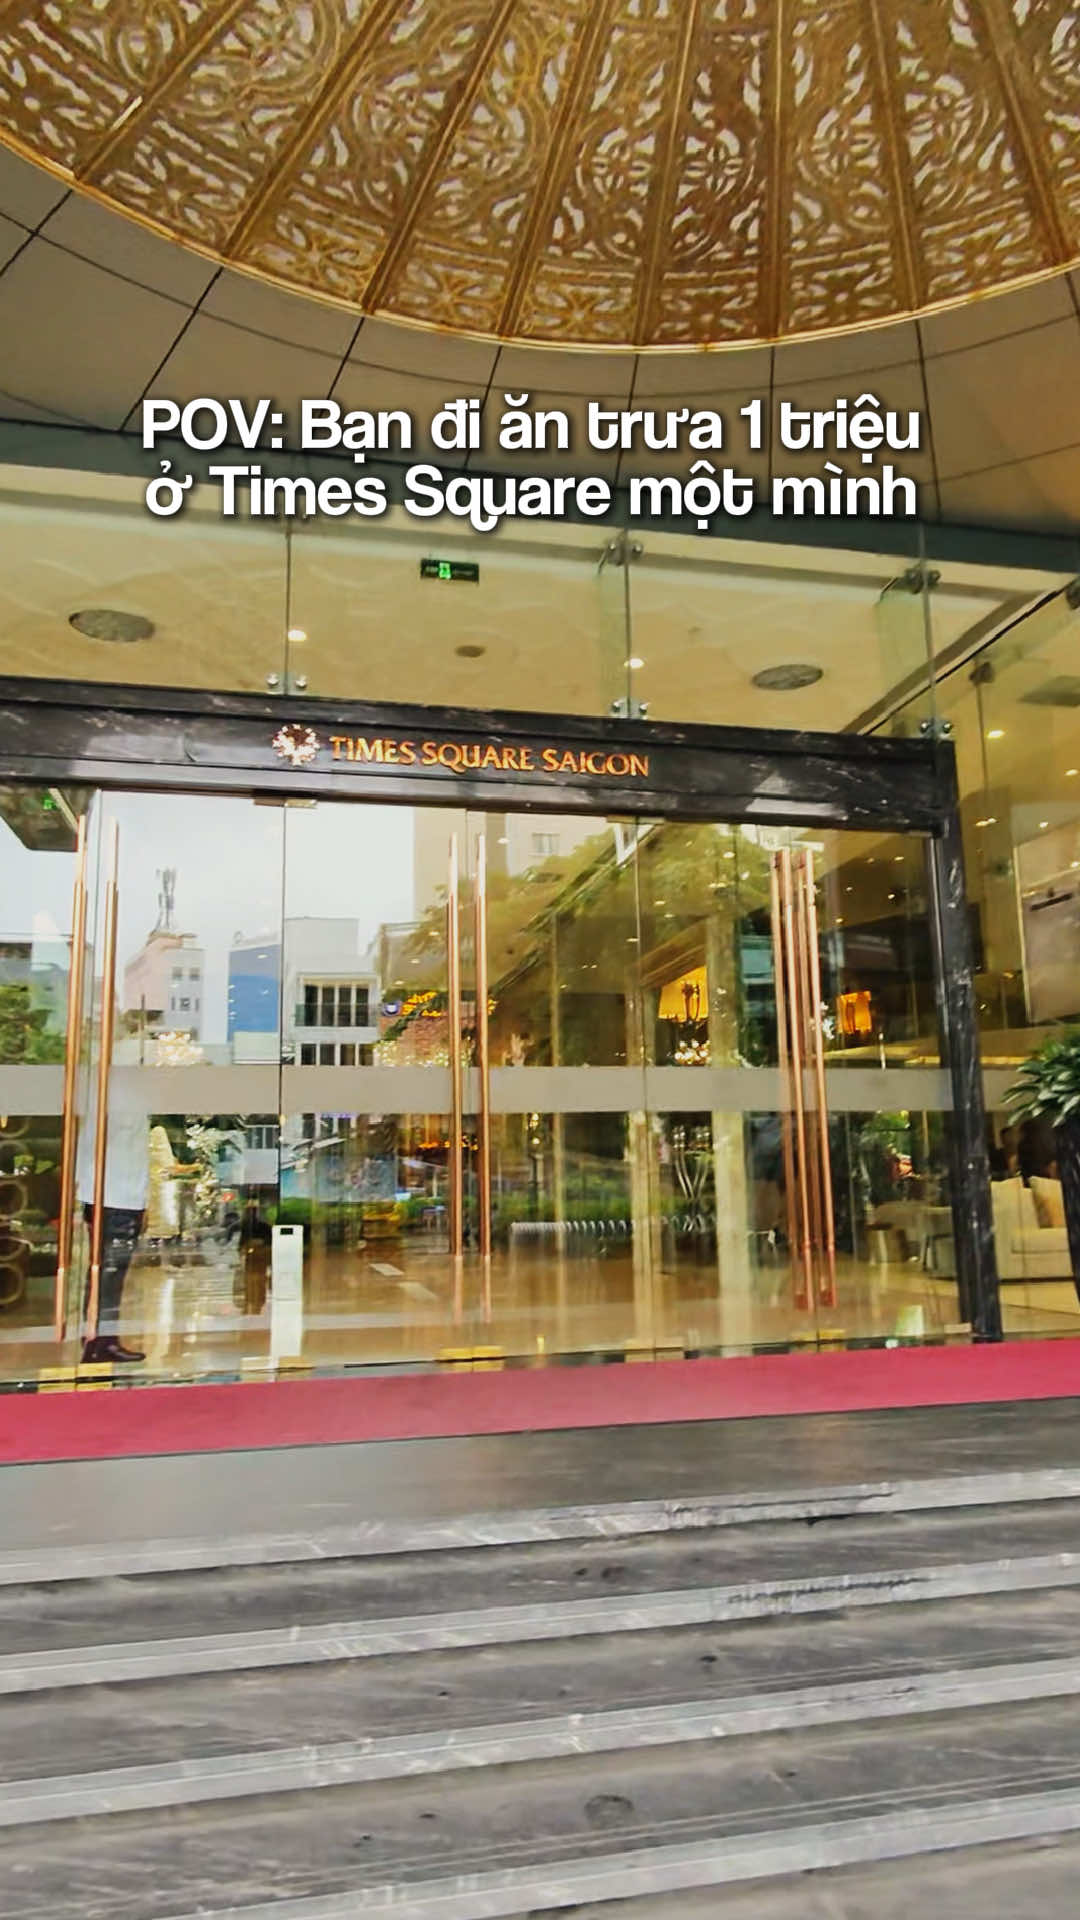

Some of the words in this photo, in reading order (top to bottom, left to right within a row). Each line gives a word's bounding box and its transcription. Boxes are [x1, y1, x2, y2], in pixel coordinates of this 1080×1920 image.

[329, 735, 417, 765] TIMES
[421, 740, 535, 773] SQUARE
[541, 747, 649, 777] SAIGON
